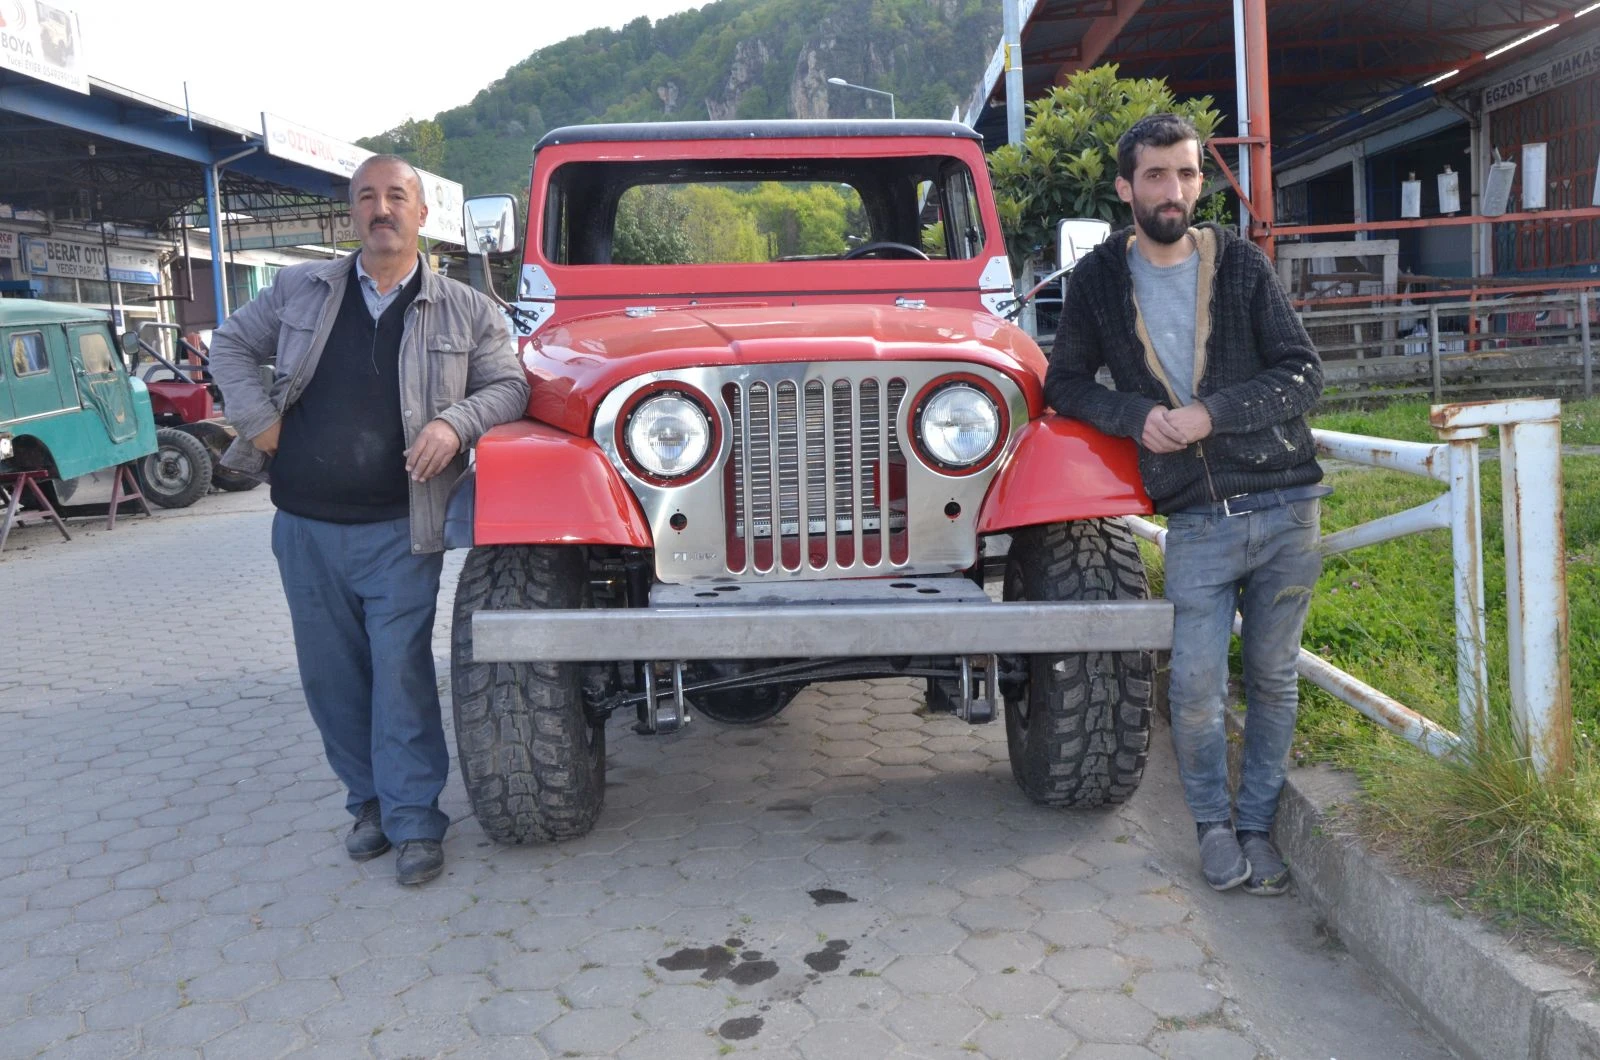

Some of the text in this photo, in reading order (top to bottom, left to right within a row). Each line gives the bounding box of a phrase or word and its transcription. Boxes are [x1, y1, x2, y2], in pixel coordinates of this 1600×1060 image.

[1, 32, 34, 58] BOYA
[1485, 75, 1530, 105] EGZOST
[1534, 72, 1548, 87] ve
[47, 241, 106, 266] BERAT OTO
[56, 262, 78, 276] YEDEK
